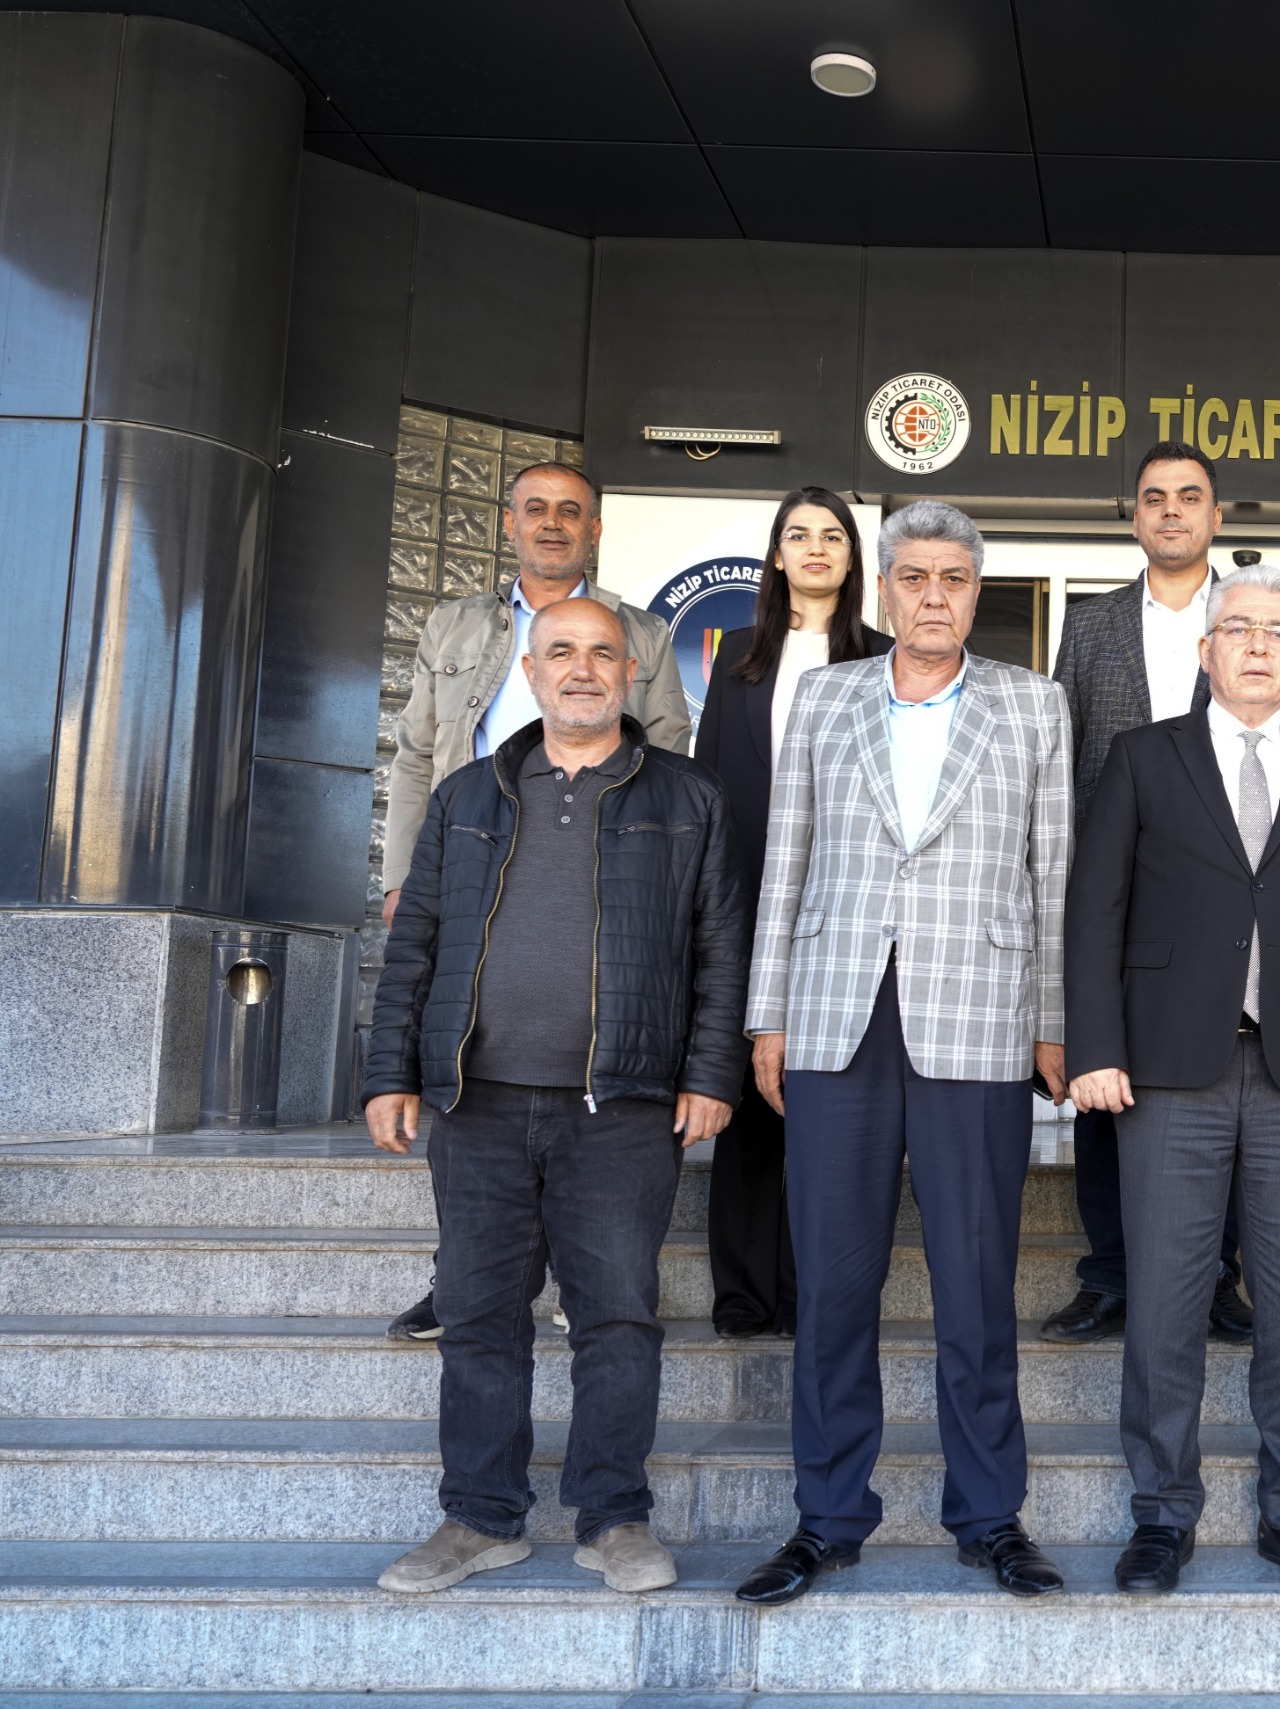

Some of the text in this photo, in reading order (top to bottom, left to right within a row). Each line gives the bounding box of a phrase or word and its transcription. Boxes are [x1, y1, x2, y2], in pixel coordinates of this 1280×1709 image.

[871, 378, 966, 422] NİZİP TİCARET ODASI
[990, 380, 1126, 457] NİZİP
[918, 418, 936, 430] NTO
[902, 461, 933, 471] 1962
[664, 565, 764, 608] NİZİP TİCARE
